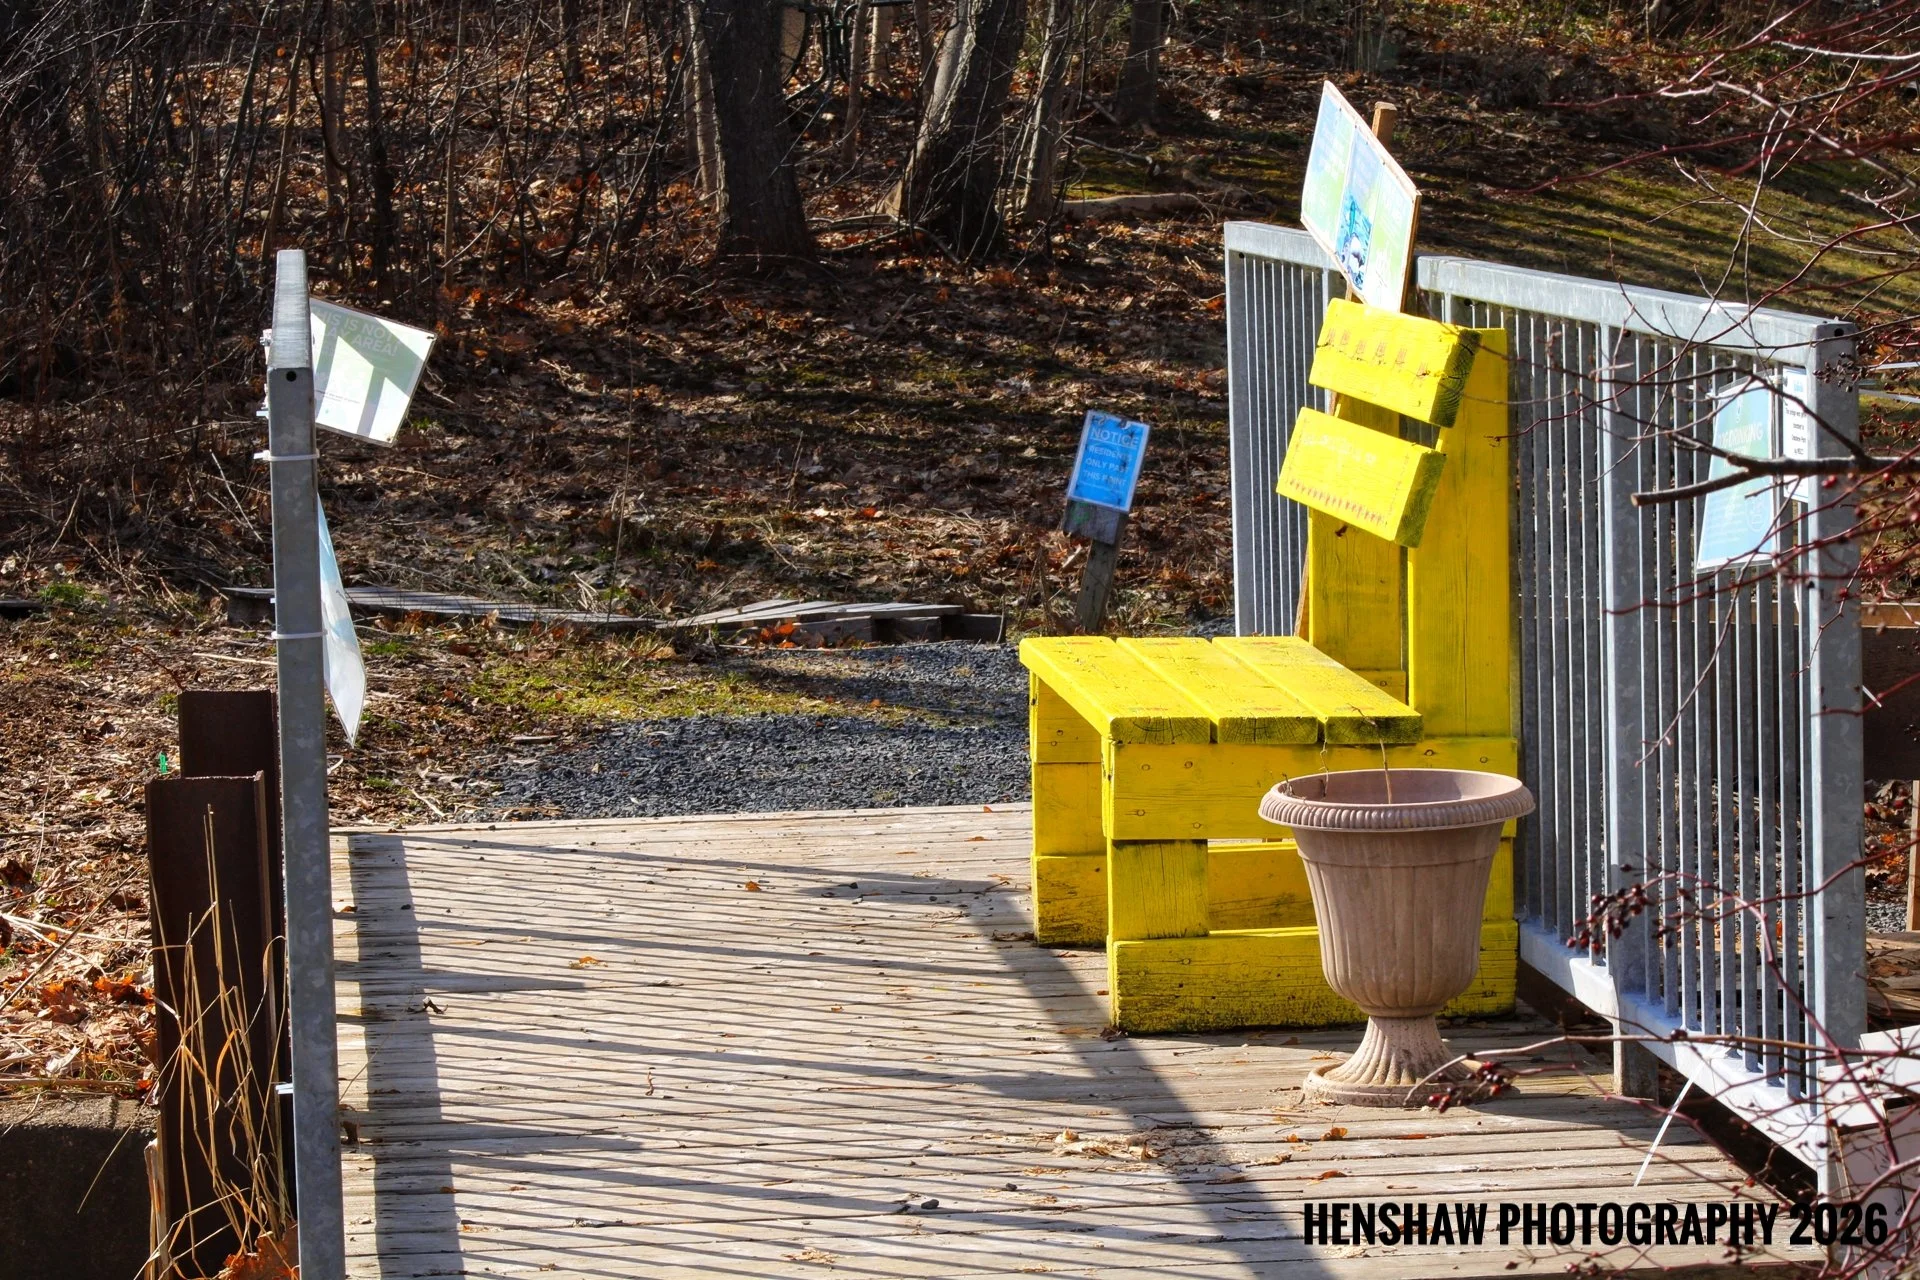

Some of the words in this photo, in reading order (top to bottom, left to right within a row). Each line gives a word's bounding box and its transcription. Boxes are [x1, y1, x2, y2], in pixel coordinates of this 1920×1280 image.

[343, 316, 359, 332] IS
[351, 335, 398, 357] AREA!
[1090, 426, 1139, 447] NOTICE
[1085, 457, 1107, 469] ONLY
[1083, 469, 1100, 481] THIS
